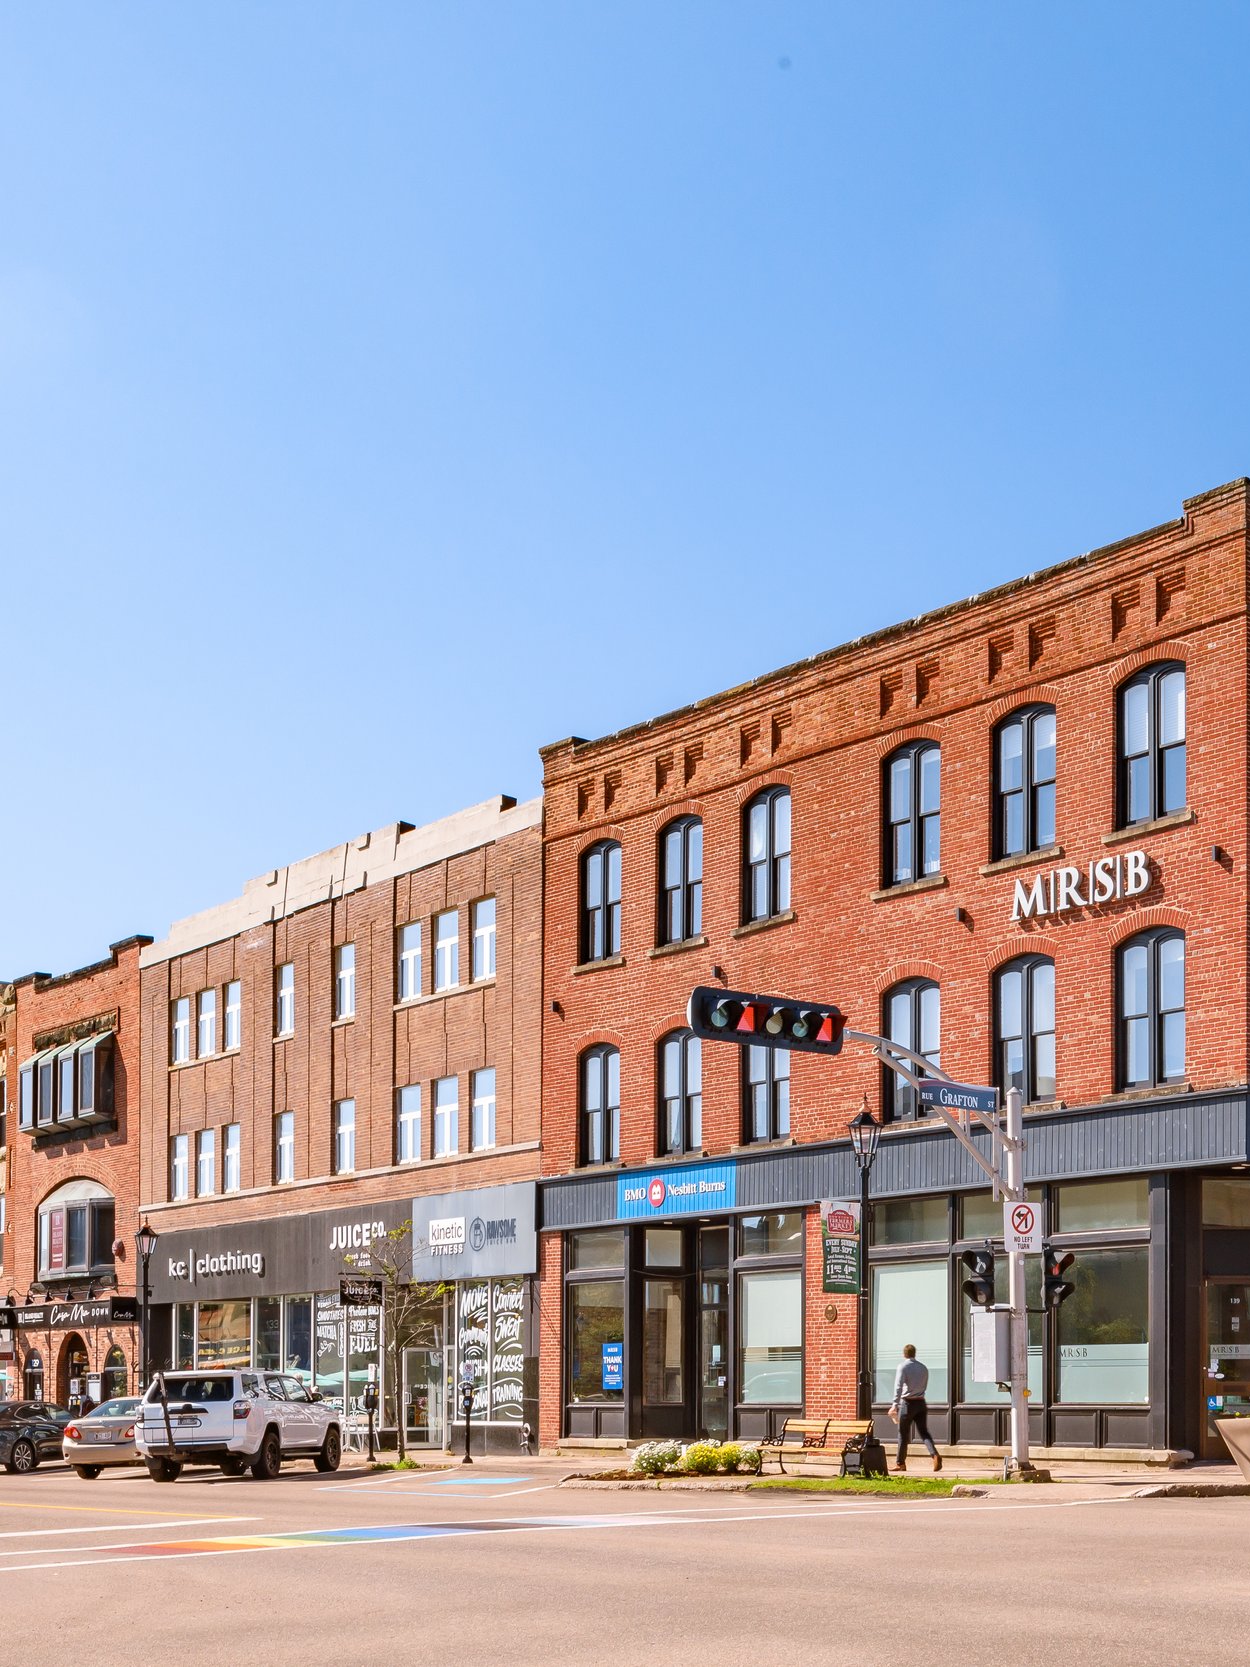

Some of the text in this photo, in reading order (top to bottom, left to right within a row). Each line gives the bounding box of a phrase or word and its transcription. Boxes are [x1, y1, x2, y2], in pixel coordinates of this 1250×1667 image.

[921, 1088, 994, 1108] RUE GRAFTON ST
[625, 1181, 726, 1201] BMO Nesbitt Burns
[329, 1221, 387, 1250] JUICE CO.
[431, 1222, 463, 1241] kinetic
[486, 1218, 517, 1240] RAWSOME
[431, 1243, 463, 1256] FITNESS
[168, 1249, 262, 1277] kc clothing
[343, 1284, 369, 1295] JUICE
[460, 1285, 488, 1318] MOVE
[50, 1305, 70, 1325] Casa
[69, 1304, 90, 1323] Mia
[317, 1309, 344, 1322] SMOOTHIES
[316, 1325, 337, 1341] MATCHA
[349, 1319, 366, 1333] FRESH
[494, 1317, 524, 1343] SWEAT
[349, 1334, 378, 1355] FUEL
[1212, 1346, 1240, 1354] MRSB
[492, 1354, 524, 1374] CLASSES
[602, 1356, 622, 1364] THANK
[492, 1383, 524, 1404] TRAINING
